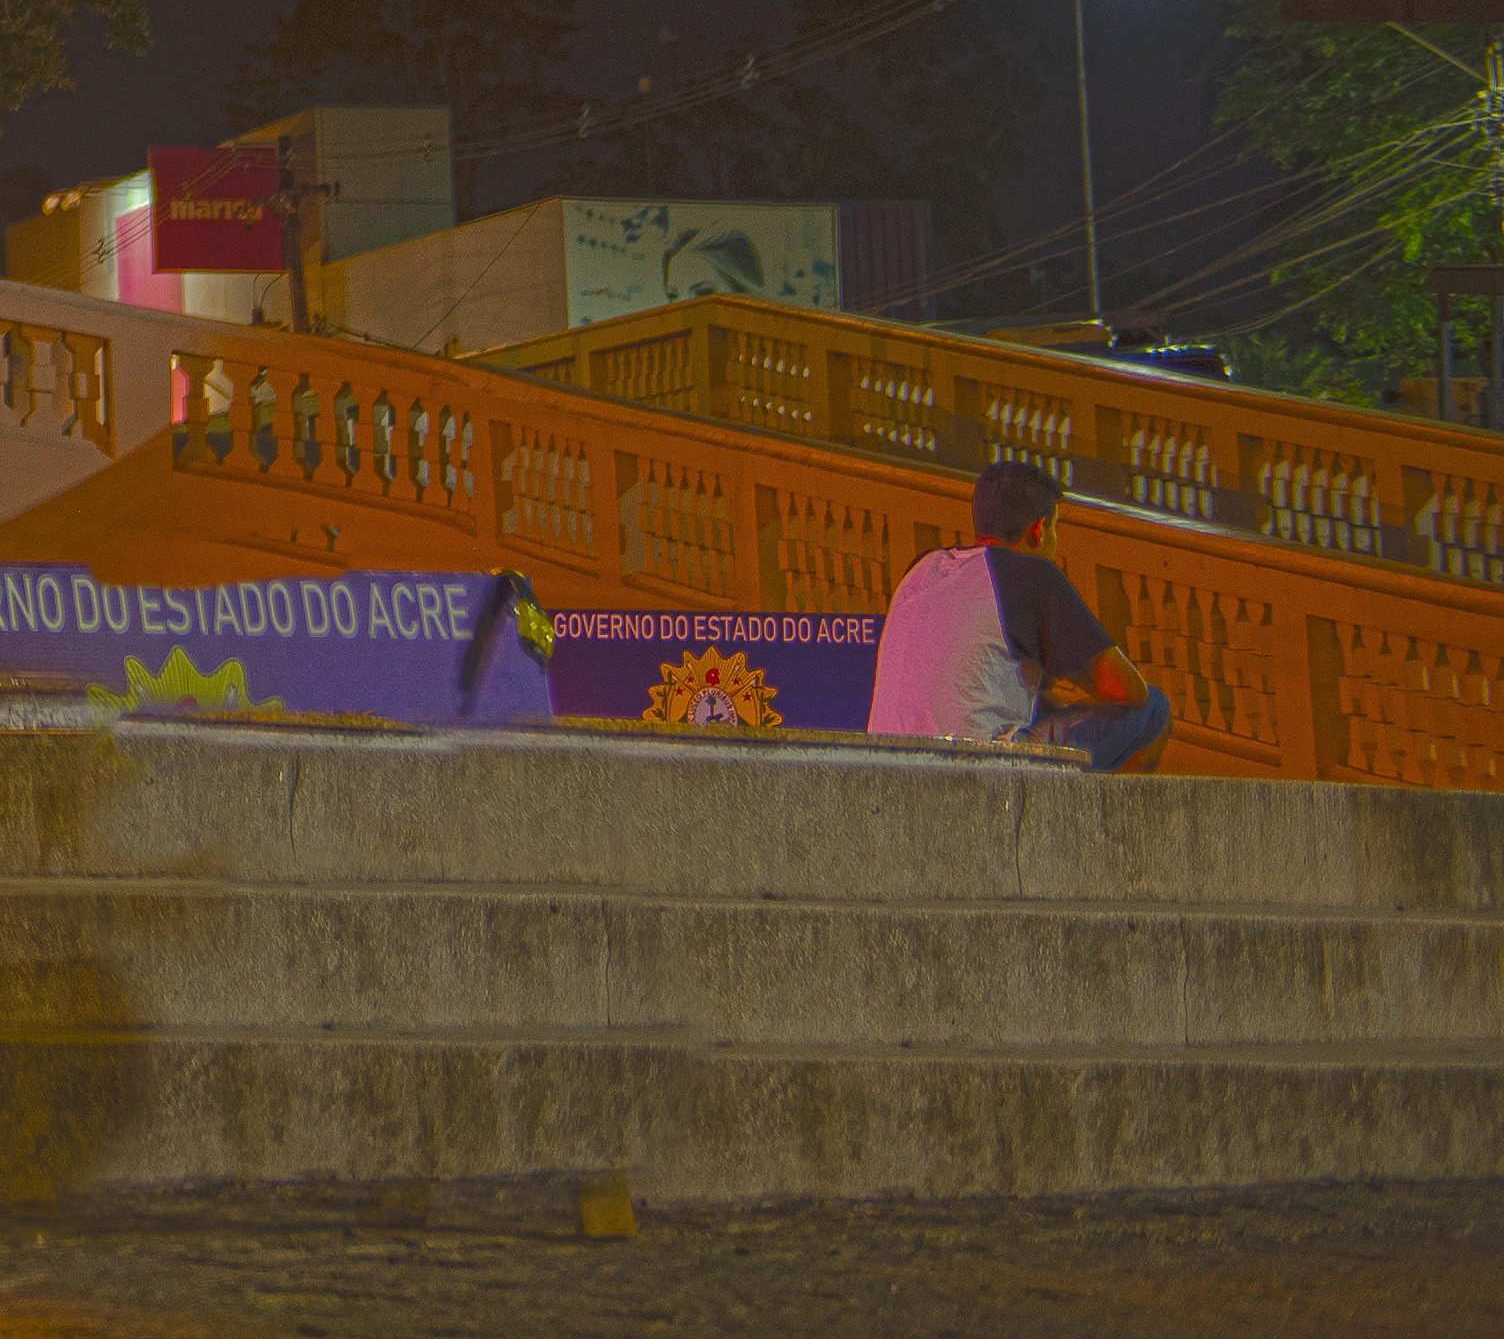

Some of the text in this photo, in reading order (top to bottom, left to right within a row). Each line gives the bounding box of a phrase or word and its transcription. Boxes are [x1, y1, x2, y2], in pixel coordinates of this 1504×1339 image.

[70, 573, 130, 634] DO
[138, 579, 296, 637] ESTADO
[299, 579, 359, 639] DO
[368, 581, 474, 641] ACRE
[553, 612, 876, 645] GOVERNO DO ESTADO DO ACRE
